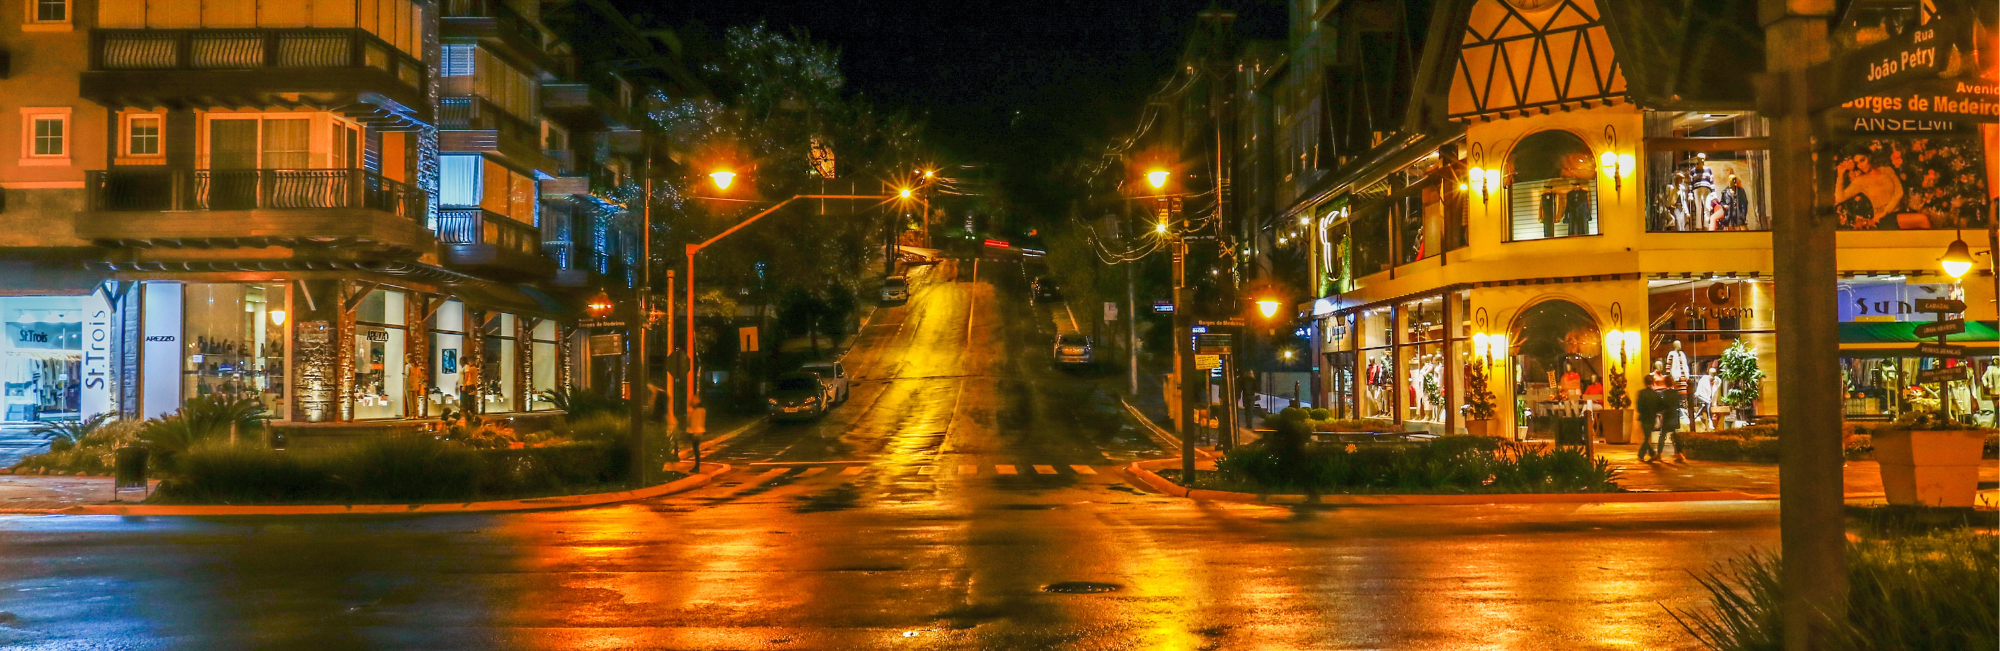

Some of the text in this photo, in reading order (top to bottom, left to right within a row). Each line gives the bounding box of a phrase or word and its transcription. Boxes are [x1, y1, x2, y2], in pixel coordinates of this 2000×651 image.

[1914, 29, 1934, 43] Rua
[1867, 47, 1935, 81] João Petry
[1908, 94, 1928, 111] de
[1857, 298, 1924, 314] Sun
[19, 330, 48, 343] St.Trois
[86, 310, 105, 390] St.Trois
